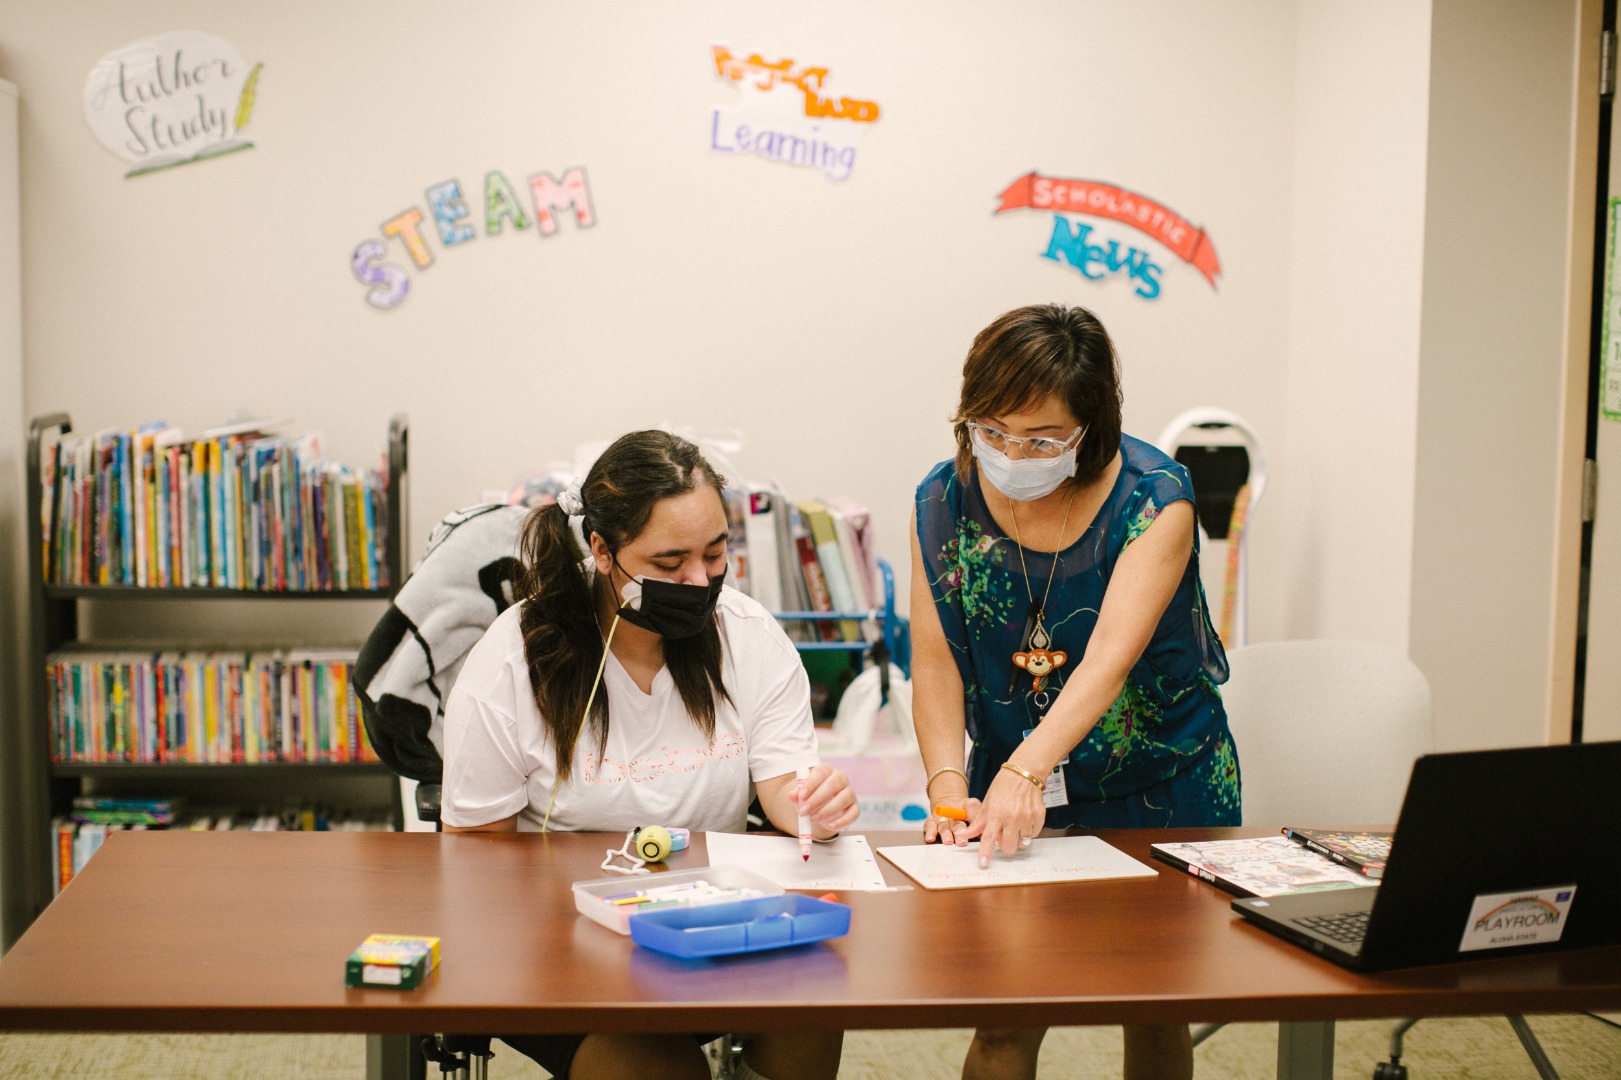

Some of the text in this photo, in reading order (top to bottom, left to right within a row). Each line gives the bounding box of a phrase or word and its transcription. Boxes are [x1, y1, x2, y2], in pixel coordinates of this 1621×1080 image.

[91, 49, 234, 111] Author
[125, 93, 228, 157] Study
[711, 108, 857, 182] Learning
[351, 165, 596, 310] STEAM
[1032, 178, 1187, 245] SCHOLASTIC
[1474, 911, 1561, 933] PLAYROOM
